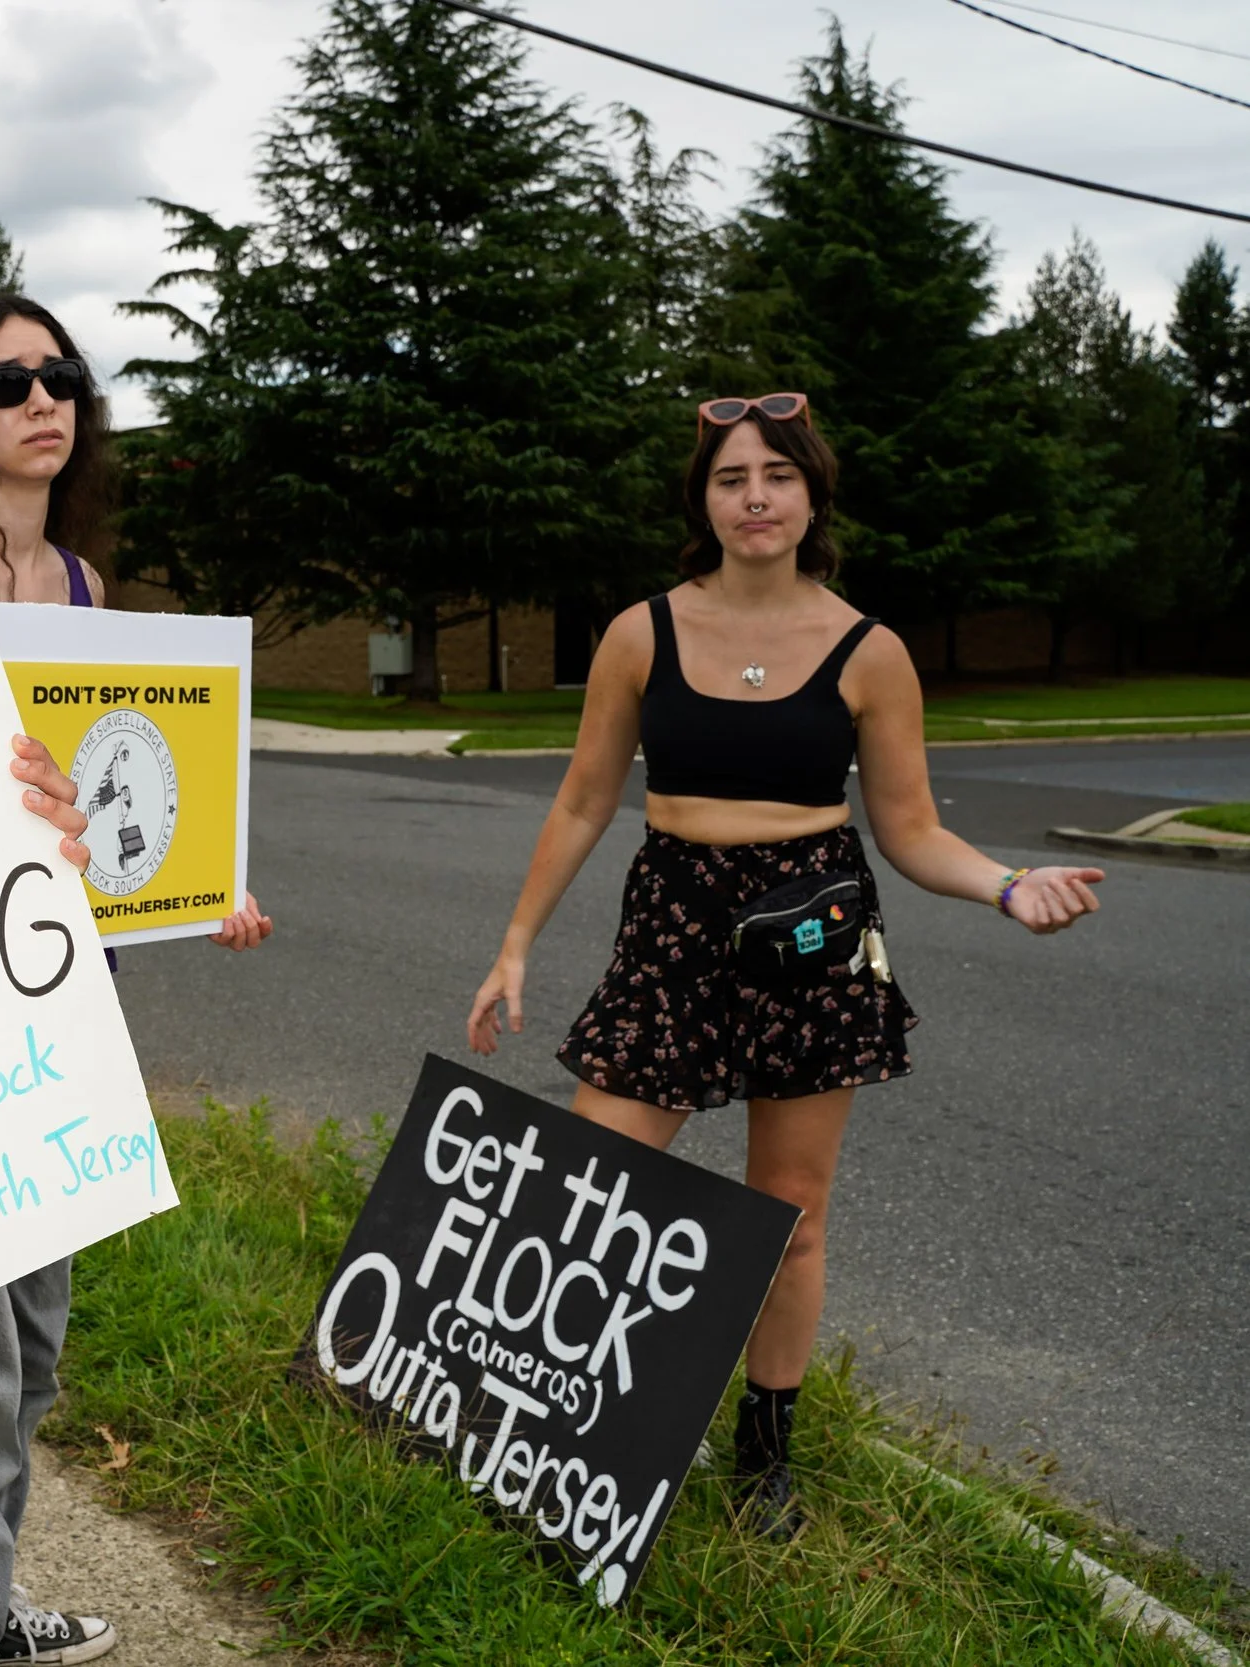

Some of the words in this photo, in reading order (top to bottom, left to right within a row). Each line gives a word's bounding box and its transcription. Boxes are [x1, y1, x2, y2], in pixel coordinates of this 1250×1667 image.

[32, 685, 95, 705] DON'T
[99, 686, 140, 705] SPY
[143, 686, 175, 704] ON
[178, 687, 211, 704] ME
[80, 731, 97, 756] THE
[96, 713, 164, 754] SURVEILLANCE
[161, 753, 177, 796] STATE
[86, 865, 110, 890] LOCK
[113, 873, 144, 894] SOUTH
[148, 821, 173, 873] JERSEY
[43, 1116, 157, 1197] Jersey
[424, 1086, 545, 1218] Get
[560, 1156, 708, 1312] the
[415, 1197, 653, 1394] FLOCK
[426, 1299, 603, 1436] (cameras)
[316, 1251, 461, 1449] Outta
[459, 1372, 670, 1608] Jersey!
